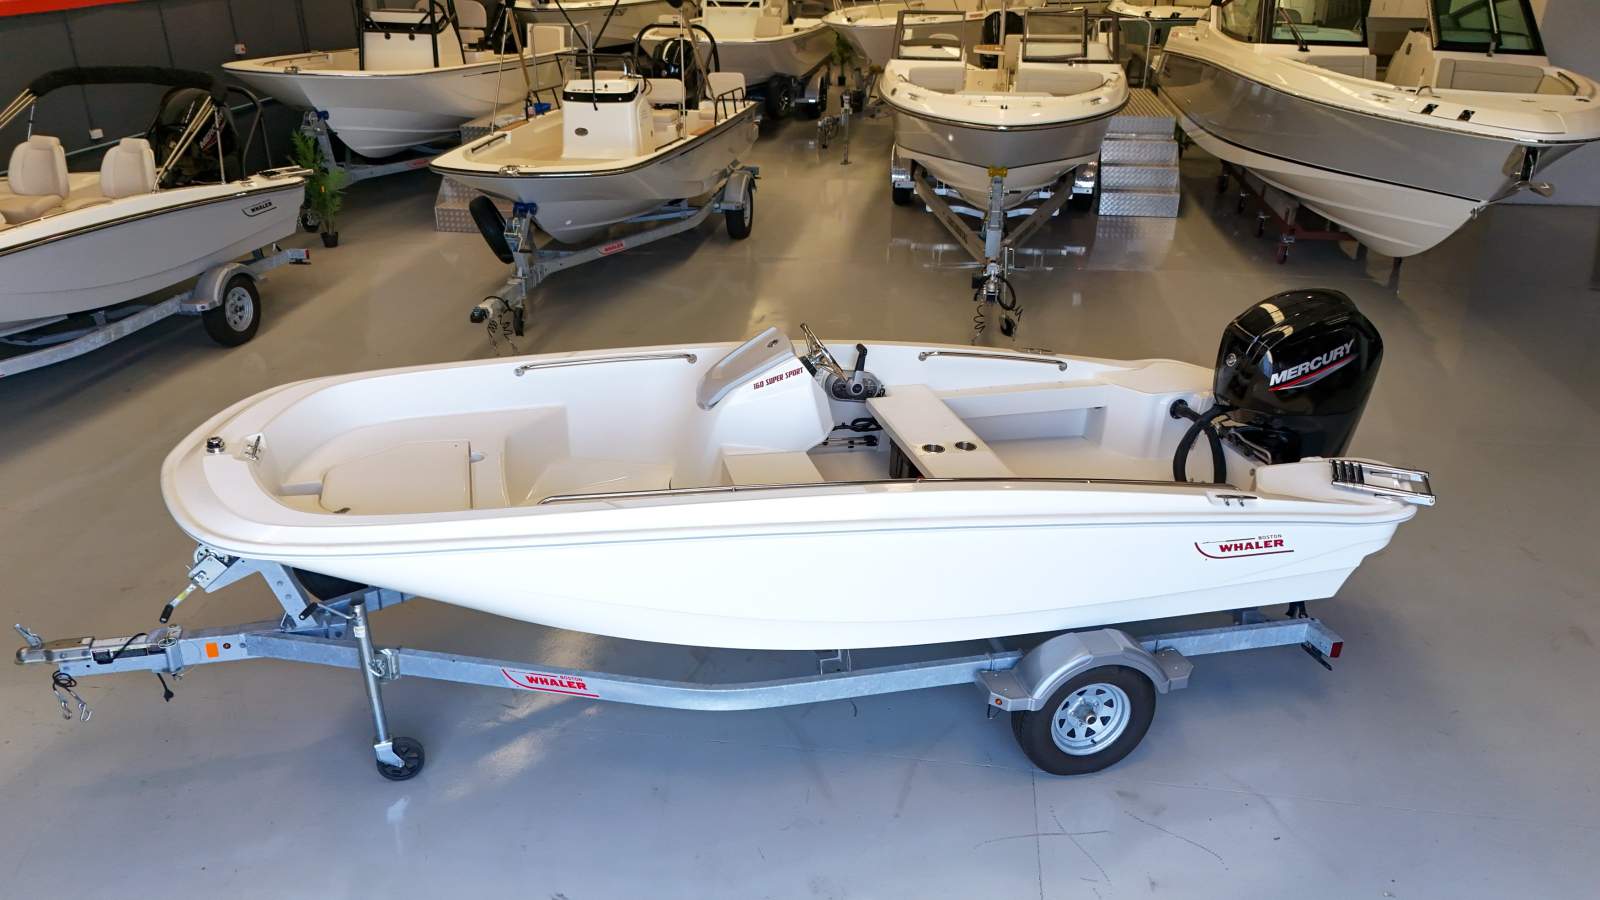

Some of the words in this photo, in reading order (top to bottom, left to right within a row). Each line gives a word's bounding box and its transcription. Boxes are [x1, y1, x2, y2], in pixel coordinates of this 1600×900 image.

[1269, 338, 1355, 386] MERCURY
[753, 380, 764, 390] 160
[765, 374, 783, 385] SUPER
[785, 367, 803, 379] SPORT
[1219, 539, 1284, 553] WHALER
[525, 675, 587, 690] WHALER
